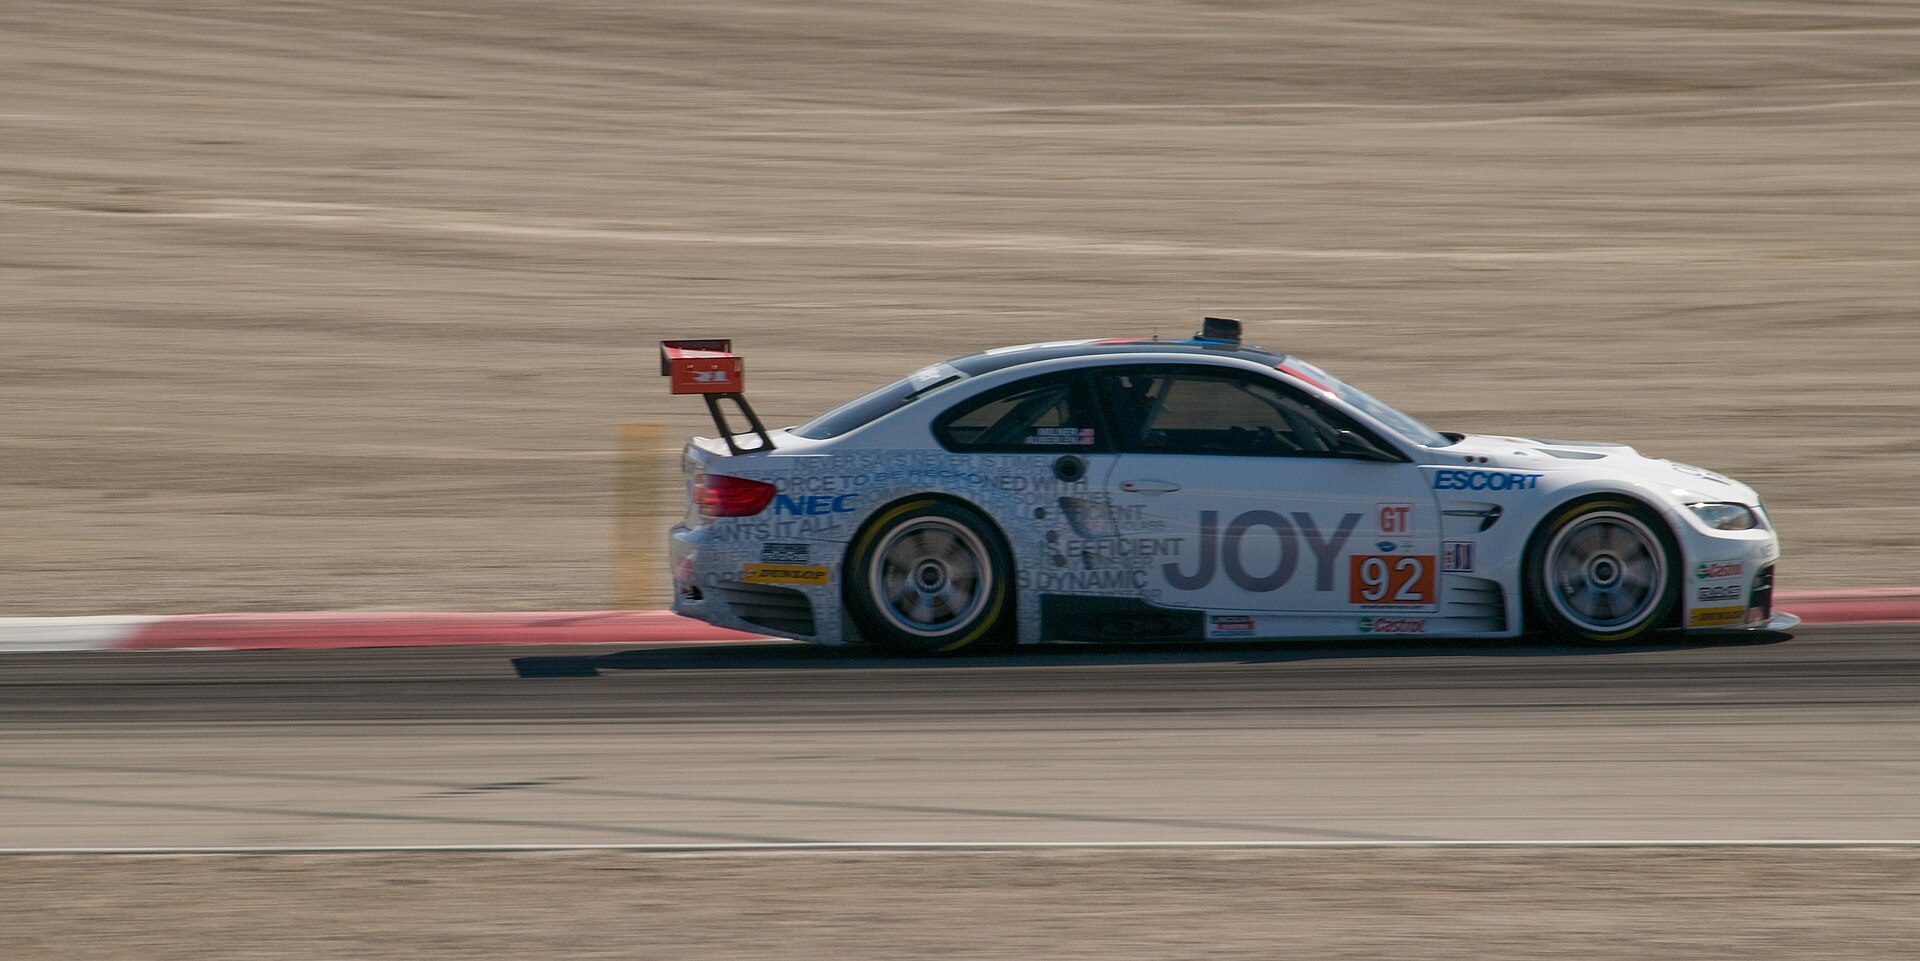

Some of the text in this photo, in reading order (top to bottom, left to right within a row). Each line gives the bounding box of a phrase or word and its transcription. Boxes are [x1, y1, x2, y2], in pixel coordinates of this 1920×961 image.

[839, 474, 867, 491] TO
[874, 471, 903, 482] BE
[1434, 470, 1544, 491] ESCORT
[775, 493, 859, 516] NEC
[1379, 506, 1411, 533] GT
[1066, 537, 1185, 558] EFFICIENT
[1162, 509, 1365, 593] JOY
[758, 568, 828, 580] DUNLOP
[1036, 569, 1149, 590] DYNAMIC
[1360, 556, 1425, 601] 92
